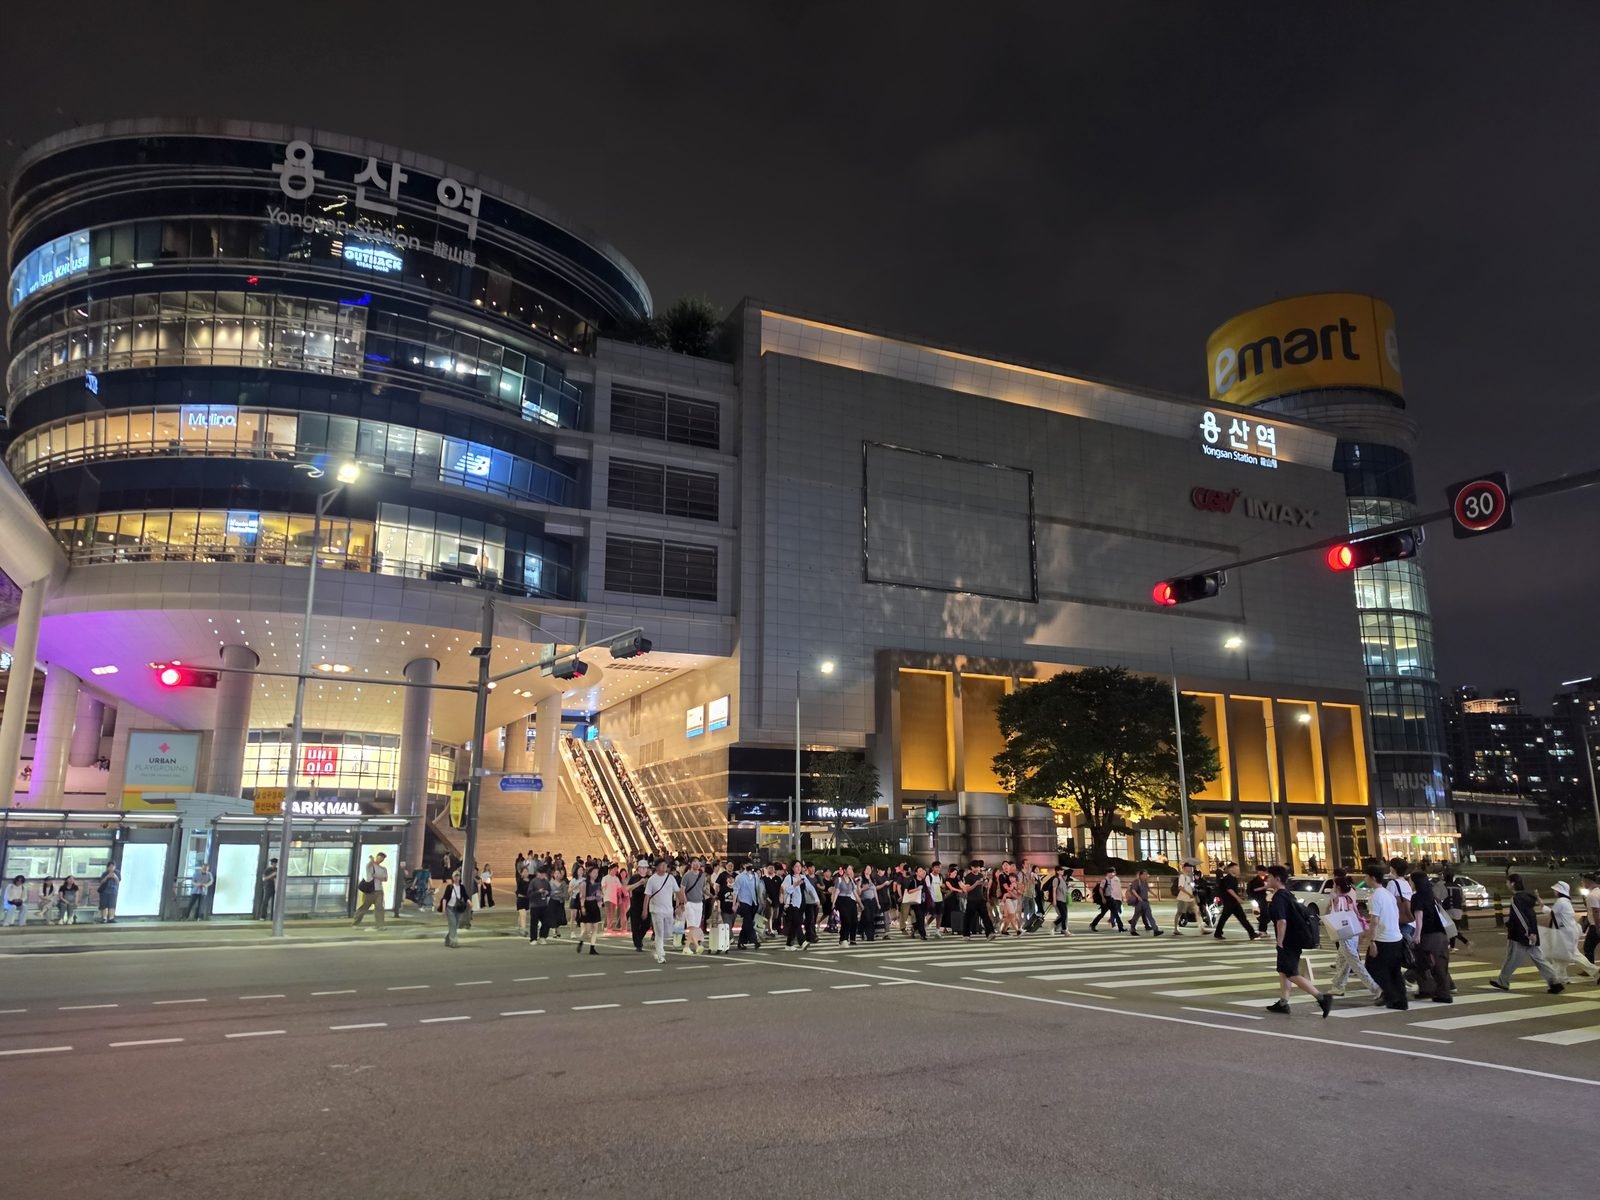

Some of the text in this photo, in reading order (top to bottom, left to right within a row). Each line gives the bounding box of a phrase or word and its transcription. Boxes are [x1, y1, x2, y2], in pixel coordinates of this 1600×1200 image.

[266, 205, 421, 250] Yongsan Station
[344, 250, 402, 271] OUTBACK
[1215, 318, 1360, 394] emart
[188, 413, 236, 426] Mulino
[1202, 444, 1258, 465] Yongsan Station
[1245, 497, 1316, 528] IMAX
[1465, 492, 1494, 518] 30
[149, 757, 177, 765] URBAN
[307, 749, 333, 760] UNI
[306, 762, 334, 775] QLO
[326, 802, 362, 815] MALL
